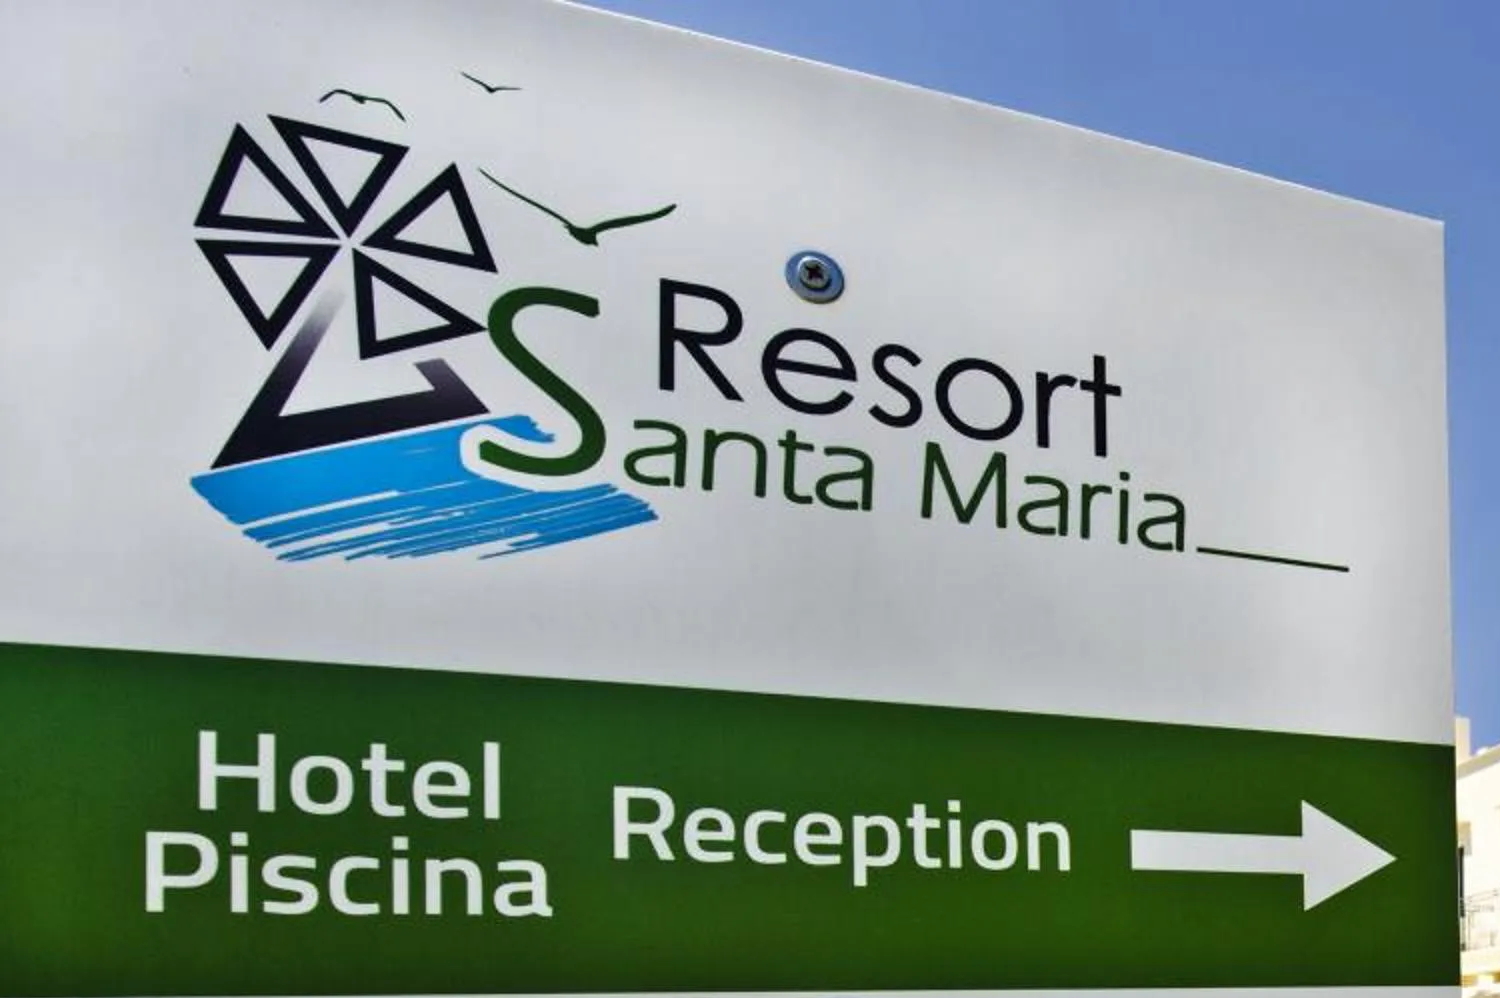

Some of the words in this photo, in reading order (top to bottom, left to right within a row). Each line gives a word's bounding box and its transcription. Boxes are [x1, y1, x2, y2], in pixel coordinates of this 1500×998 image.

[657, 277, 1123, 458] Resort
[478, 286, 875, 511] Santa
[920, 441, 1188, 552] Maria
[196, 729, 502, 821] Hotel
[143, 830, 553, 918] Piscina
[611, 785, 1072, 887] Reception
